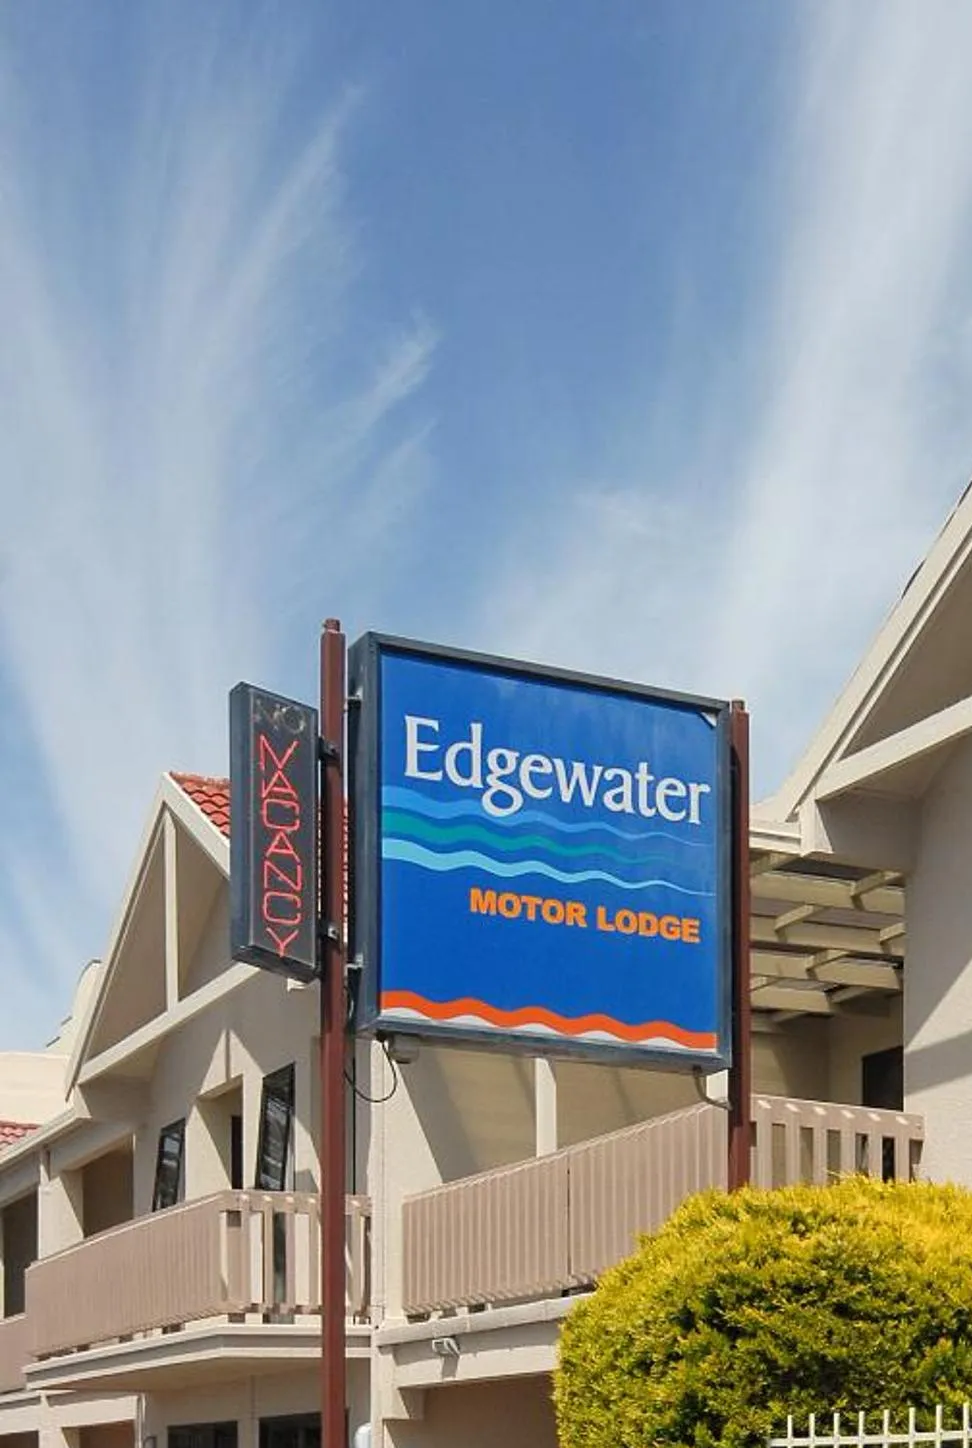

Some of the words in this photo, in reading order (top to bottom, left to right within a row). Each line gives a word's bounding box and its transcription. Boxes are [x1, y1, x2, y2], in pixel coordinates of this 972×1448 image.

[405, 715, 710, 824] Edgewater
[259, 734, 302, 957] VACANCY
[470, 888, 587, 928] MOTOR
[597, 907, 701, 943] LODGE
